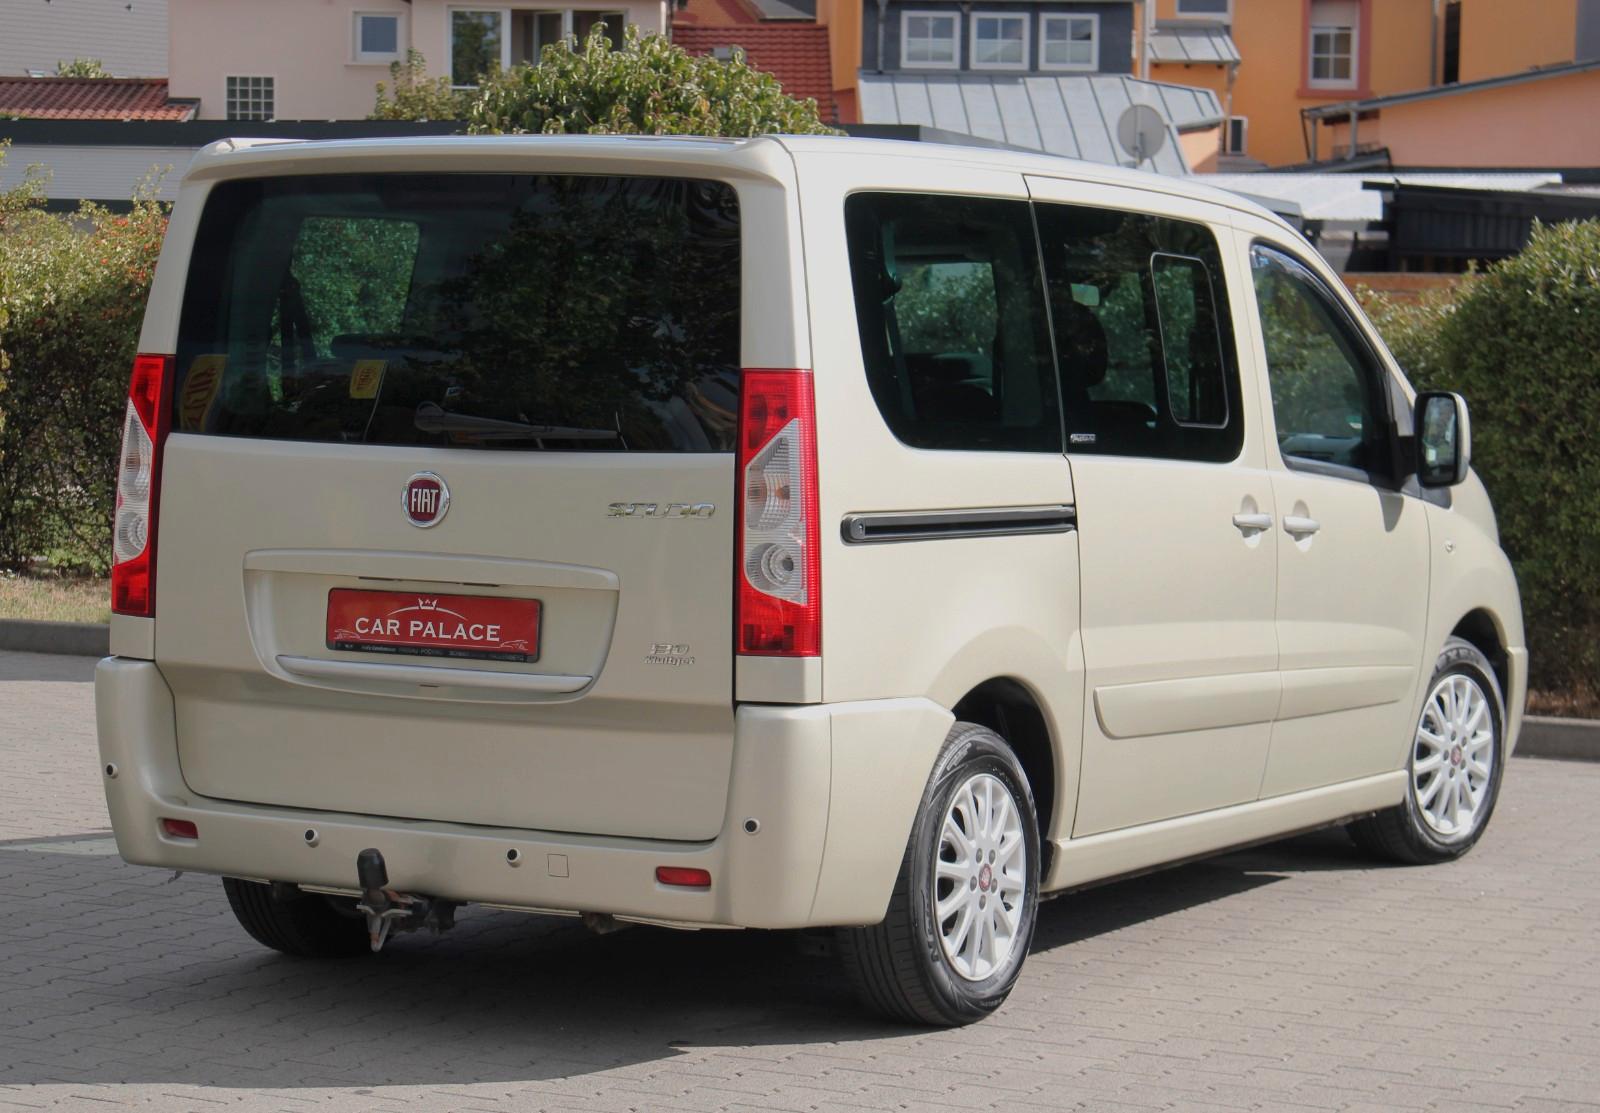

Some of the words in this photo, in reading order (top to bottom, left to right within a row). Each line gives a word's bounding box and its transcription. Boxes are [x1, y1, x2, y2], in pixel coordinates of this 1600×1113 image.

[411, 488, 439, 513] FIAT
[355, 617, 400, 636] CAR
[409, 620, 501, 642] PALACE
